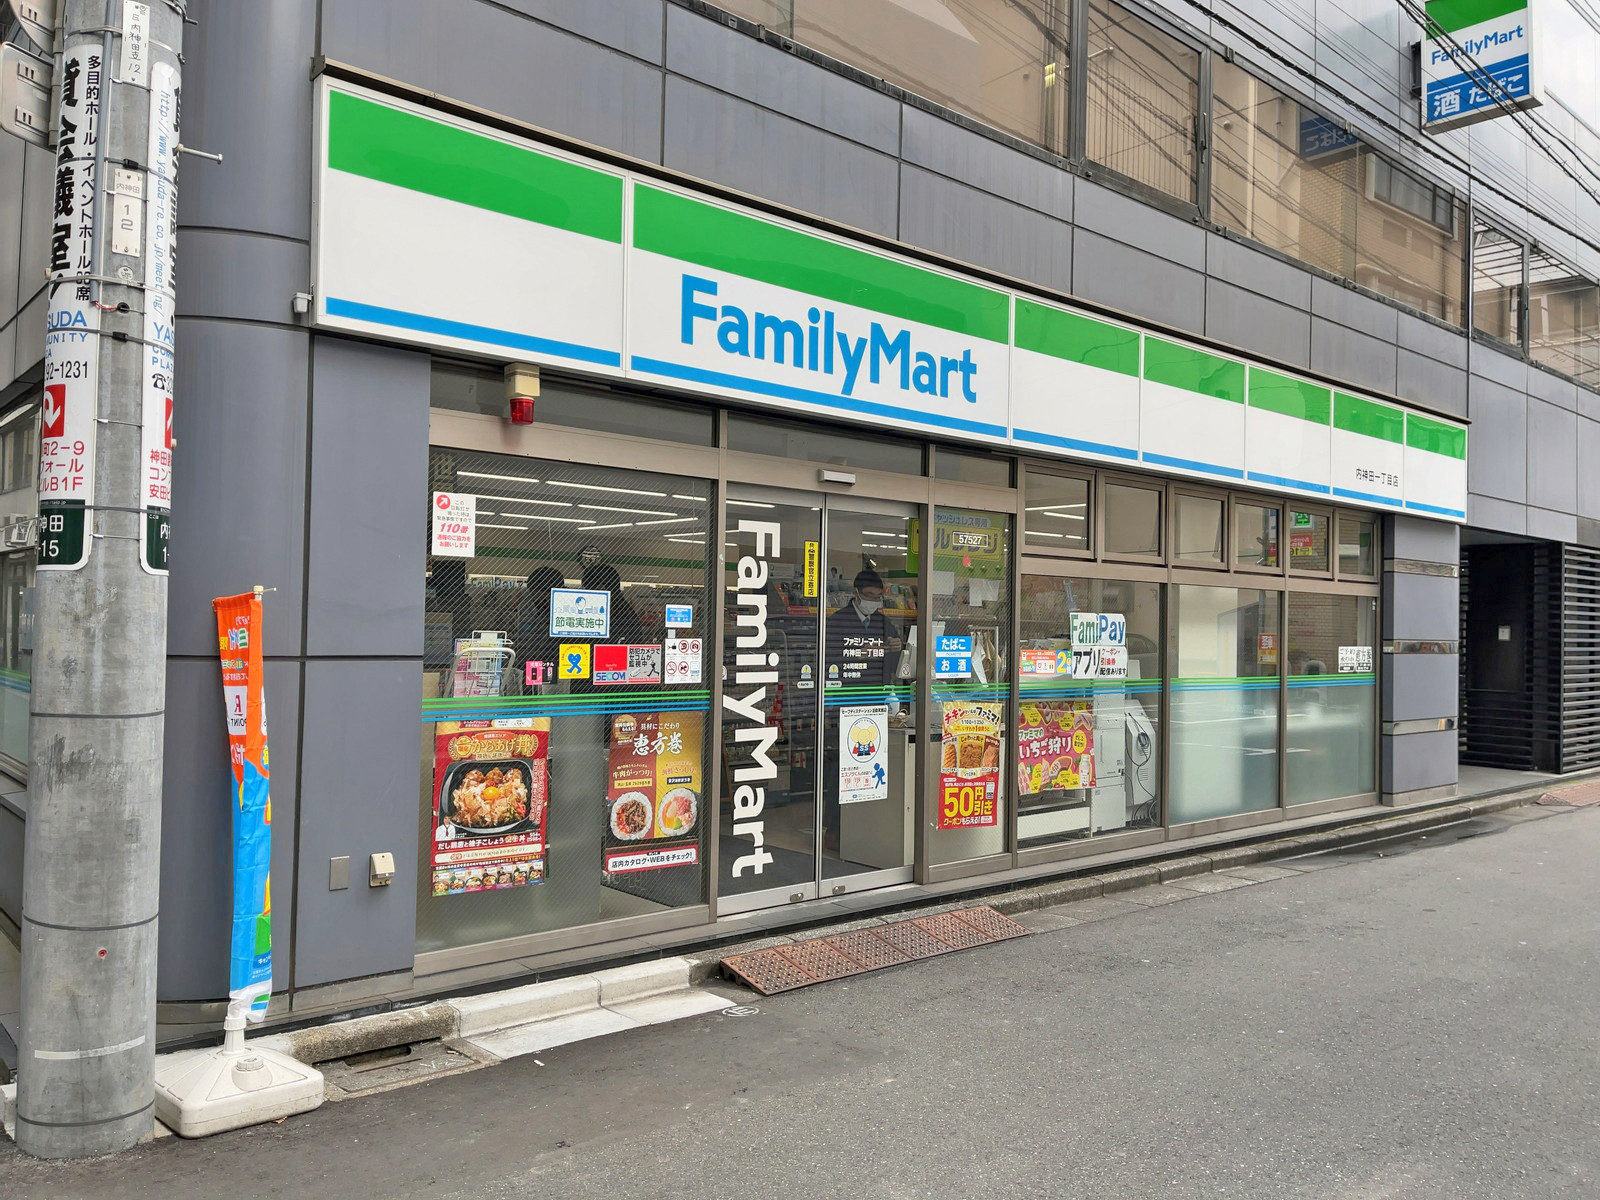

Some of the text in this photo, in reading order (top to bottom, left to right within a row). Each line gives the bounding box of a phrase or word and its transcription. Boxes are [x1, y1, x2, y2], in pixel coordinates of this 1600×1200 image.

[1431, 25, 1523, 65] FamilyMart
[1468, 74, 1524, 105] たばこ
[1433, 89, 1460, 118] 酒
[681, 273, 977, 404] FamilyMart
[1356, 468, 1399, 487] 内神田一丁目店
[936, 513, 988, 527] ャッシュレス専用
[440, 522, 469, 533] 110番
[958, 534, 983, 546] 57527
[554, 616, 604, 629] 節電実施中
[843, 637, 884, 647] ファミリーマート
[941, 637, 967, 650] たばこ
[629, 647, 660, 656] 防犯カメラで
[842, 648, 885, 657] 内神田一丁目店
[628, 660, 648, 668] 監視中
[1073, 647, 1100, 675] アプリ
[1100, 657, 1116, 666] 引換券
[596, 671, 626, 681] SECOM
[723, 519, 781, 878] FamilyMart
[640, 722, 680, 730] 具材にこだわり
[1018, 728, 1044, 740] ファミマの
[472, 735, 530, 754] からあげ丼
[632, 731, 683, 756] 恵方巻
[1018, 736, 1071, 759] いちご狩り
